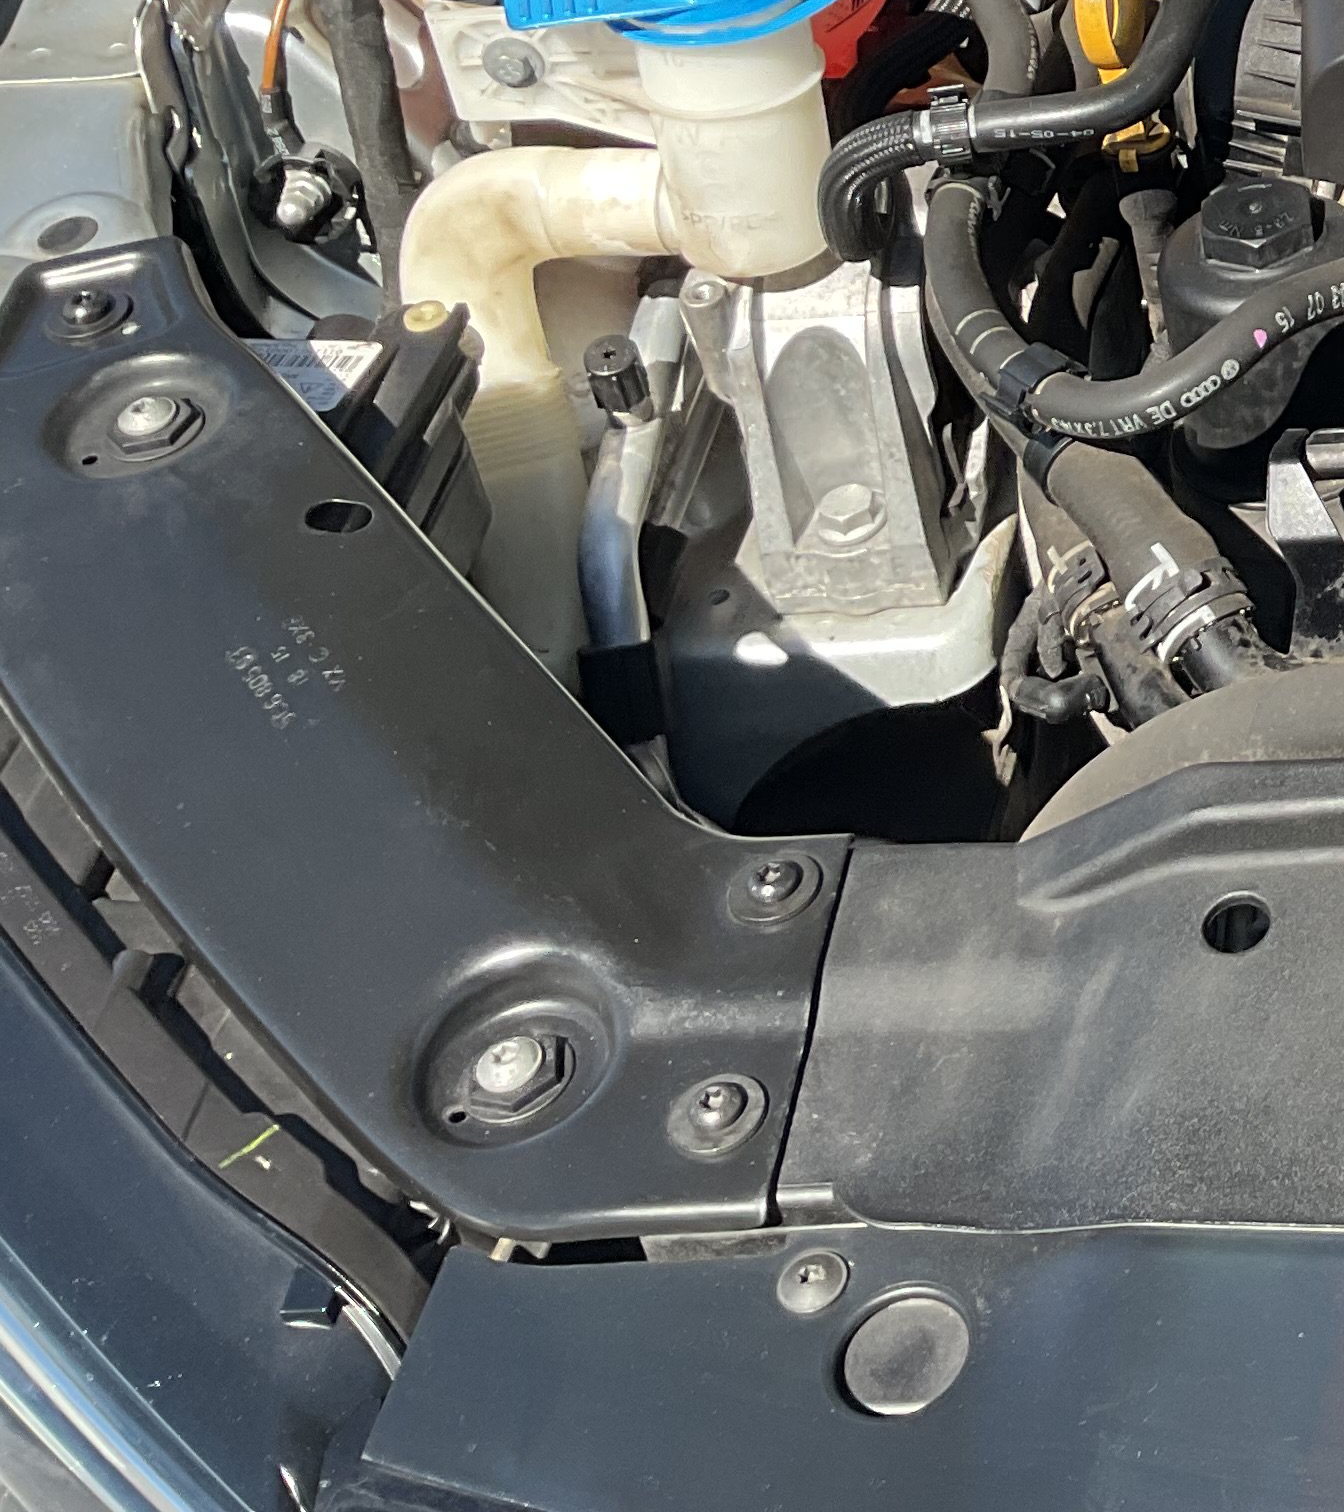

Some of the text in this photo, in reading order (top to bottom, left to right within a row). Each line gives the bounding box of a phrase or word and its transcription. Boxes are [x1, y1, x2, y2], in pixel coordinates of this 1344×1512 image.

[993, 128, 1095, 139] 04-05-15
[1145, 400, 1178, 425] DE
[1110, 413, 1148, 436] VRT
